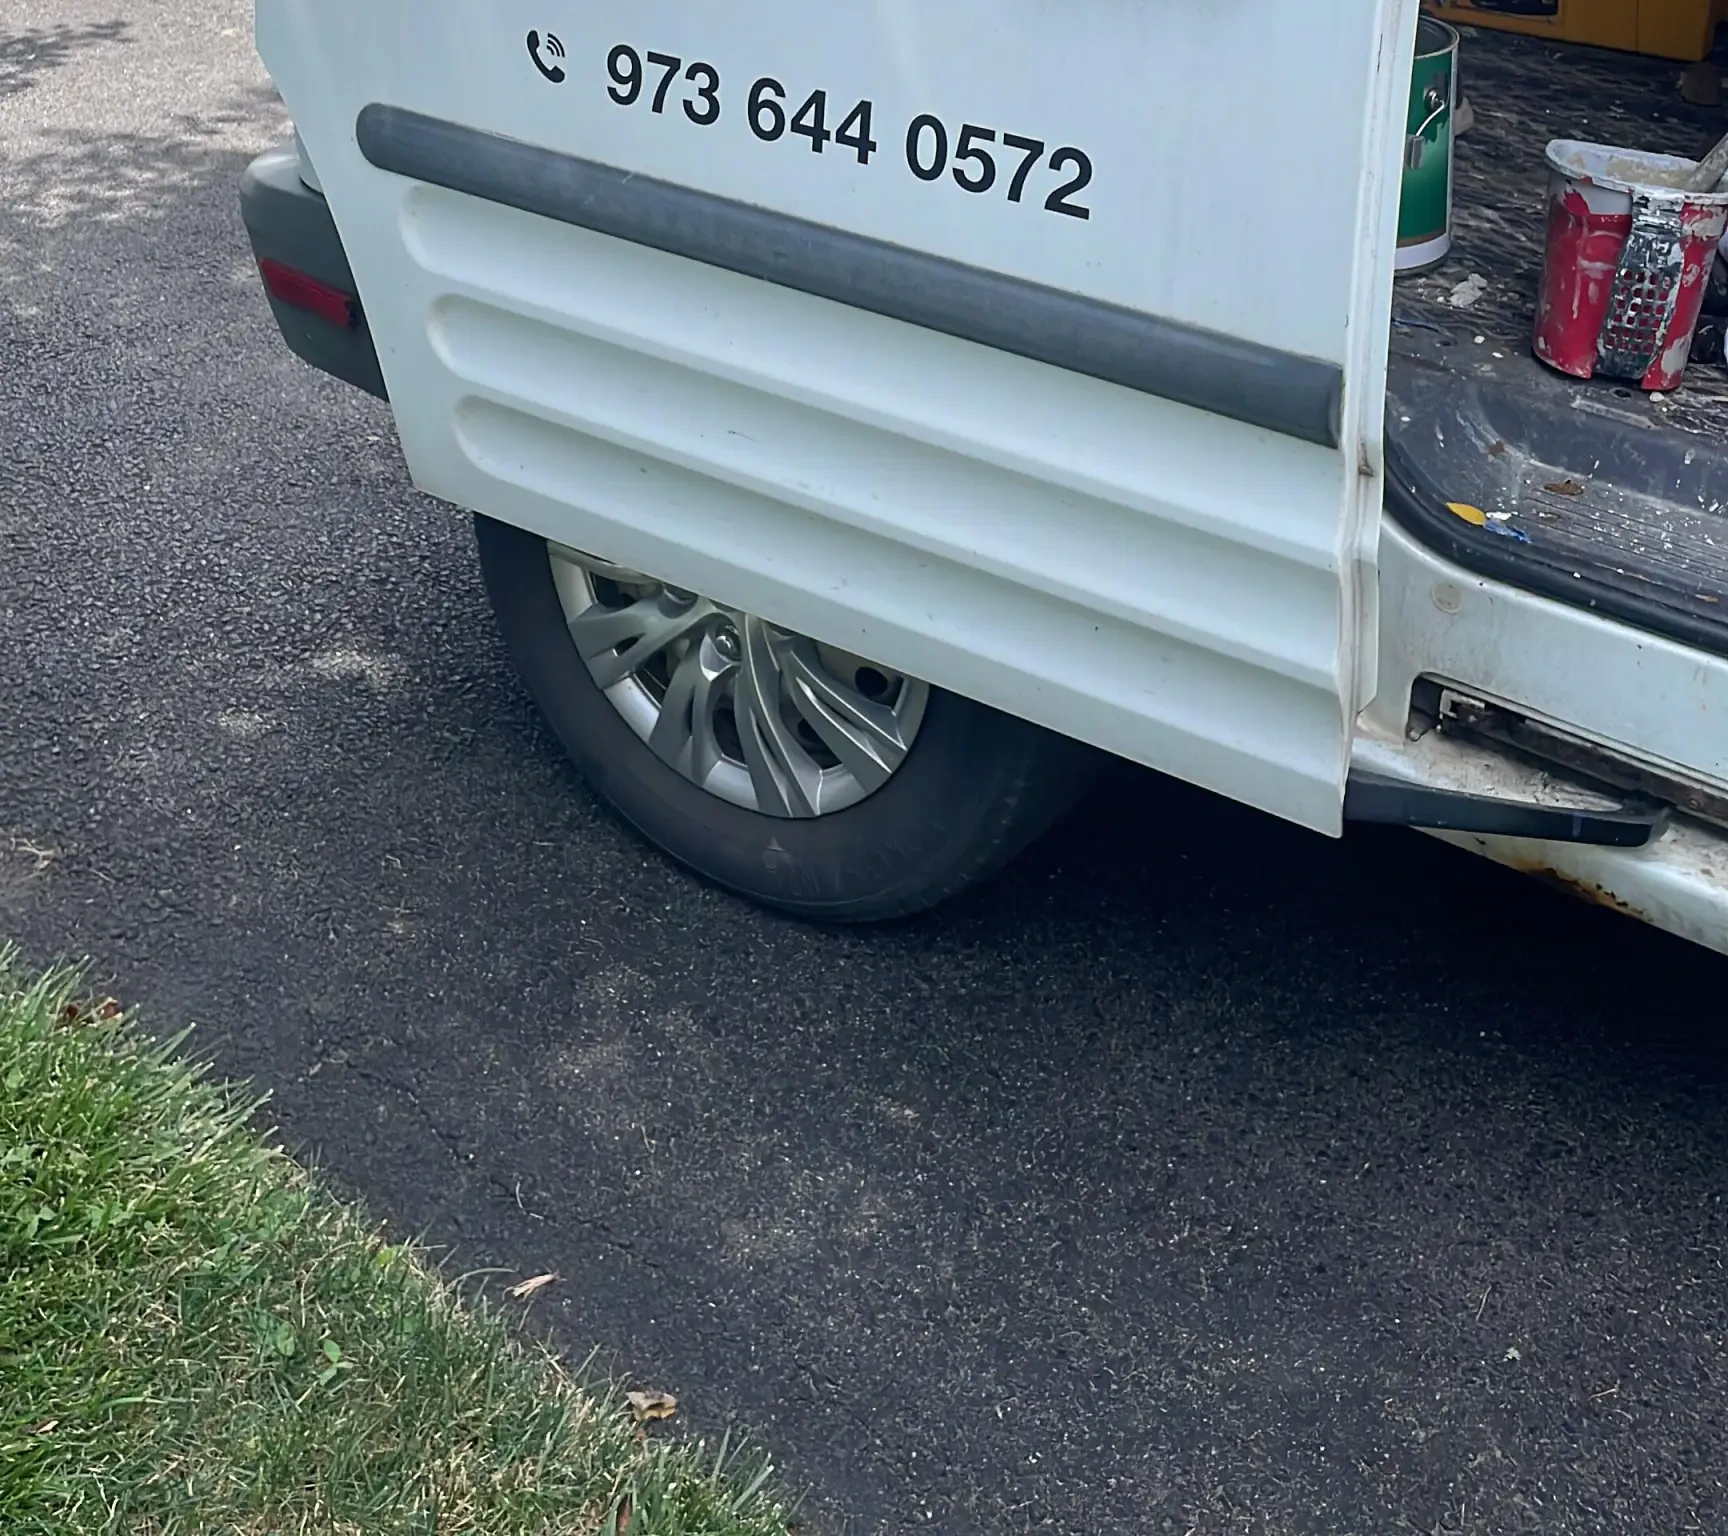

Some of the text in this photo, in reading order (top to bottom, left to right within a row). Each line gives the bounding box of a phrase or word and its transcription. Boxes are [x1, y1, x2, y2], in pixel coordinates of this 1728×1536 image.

[606, 44, 1093, 221] 973 644 0572
